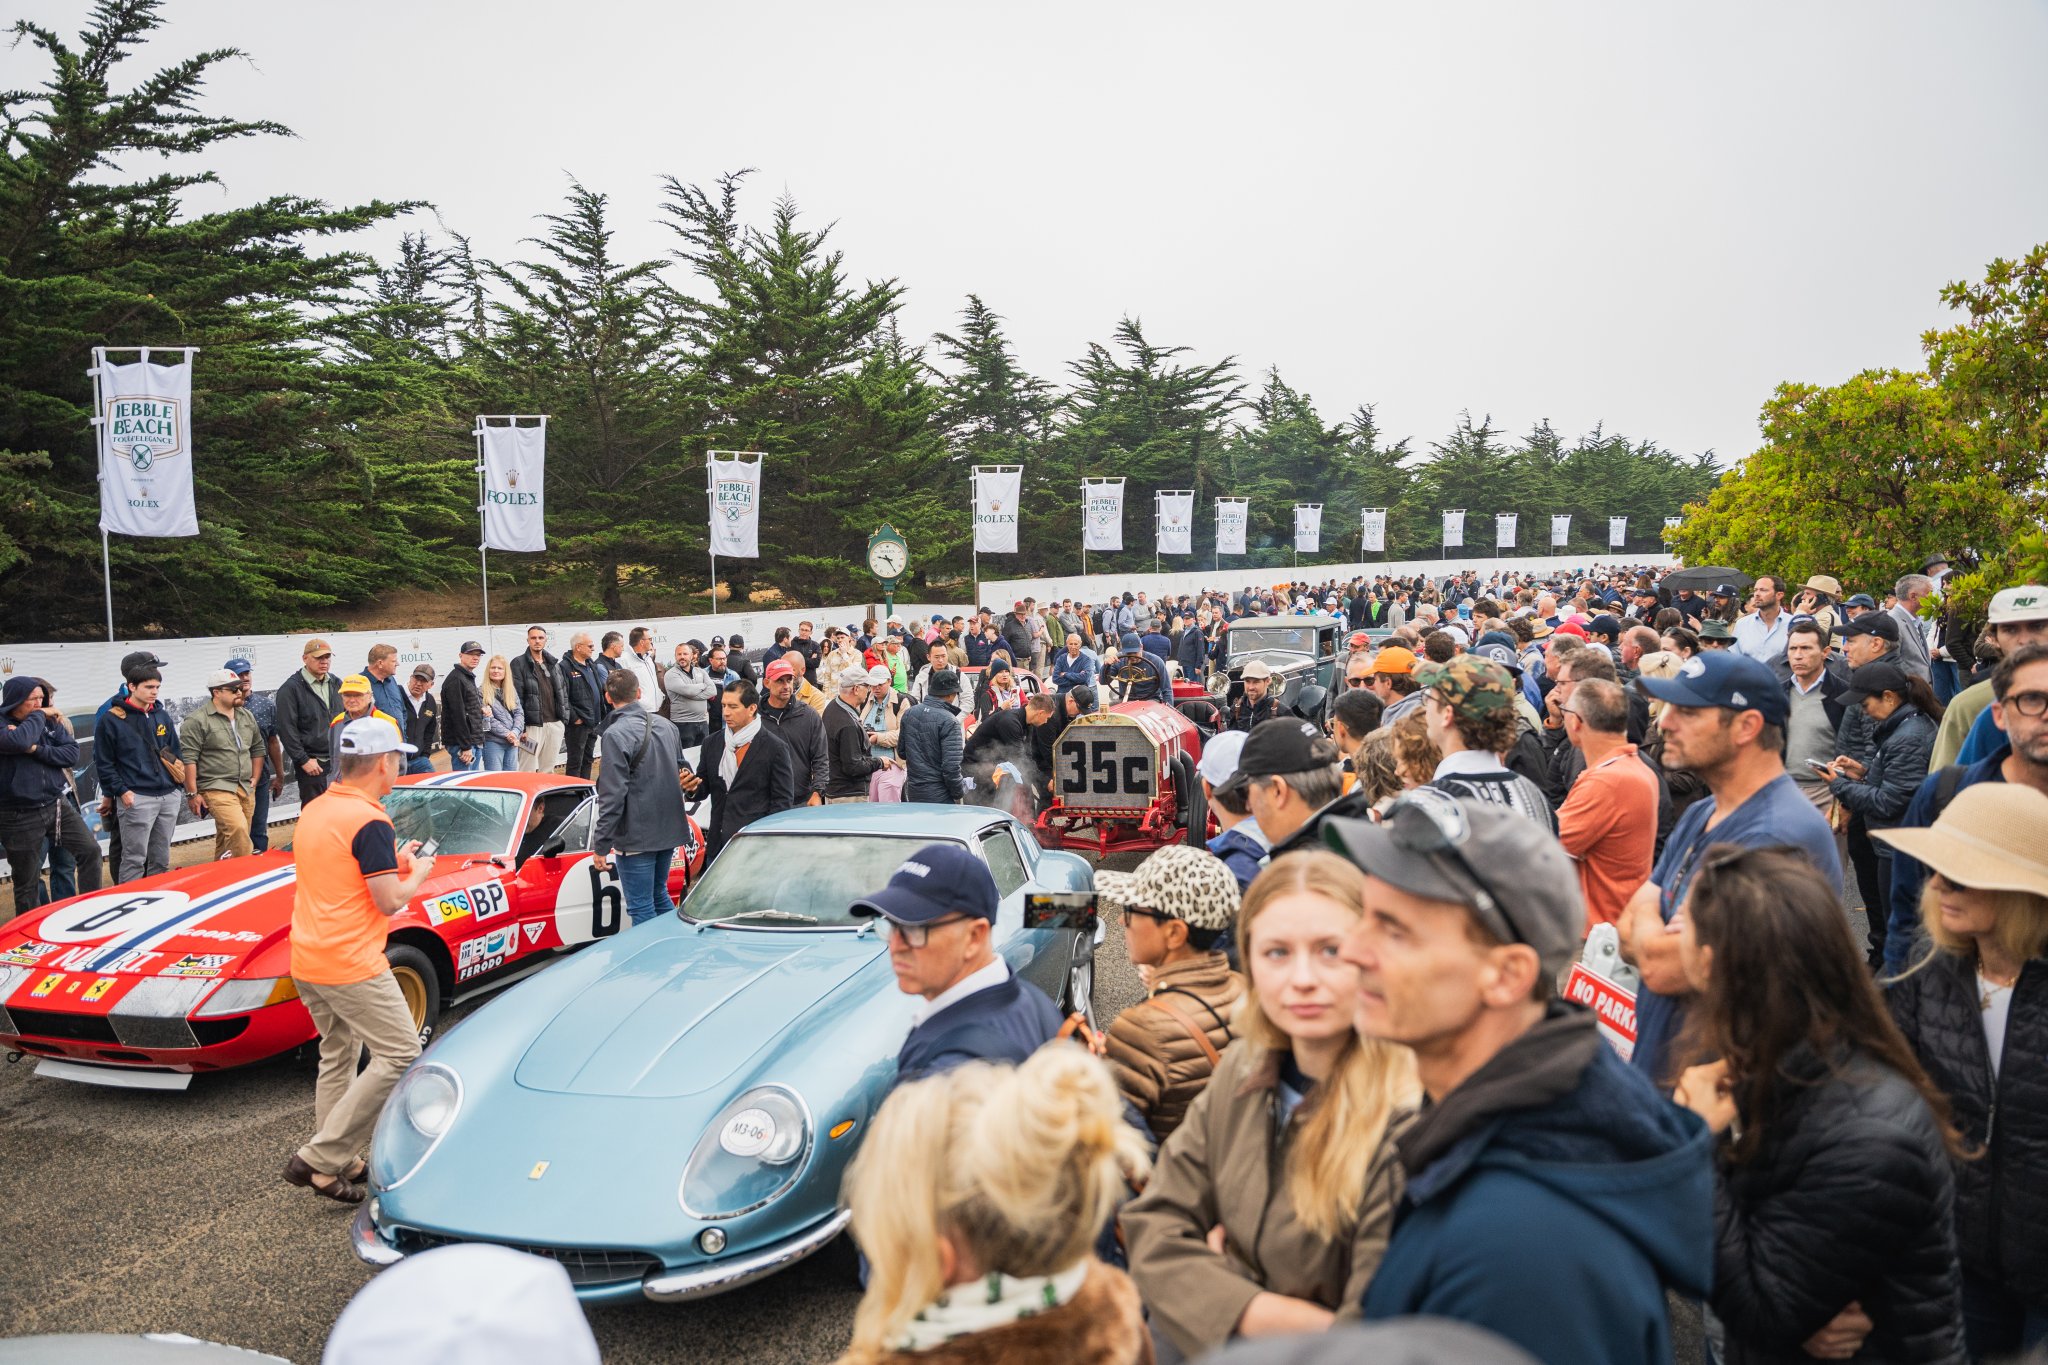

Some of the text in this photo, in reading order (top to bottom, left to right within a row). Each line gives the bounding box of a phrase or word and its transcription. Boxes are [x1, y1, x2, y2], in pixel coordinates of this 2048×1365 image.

[113, 419, 172, 436] BEACH
[718, 482, 752, 493] PEBBLE
[128, 499, 159, 508] ROLEX
[487, 490, 538, 505] ROLEX
[718, 492, 751, 502] BEACH
[1090, 504, 1117, 512] BEACH
[977, 514, 1015, 523] ROLEX
[1161, 525, 1189, 533] ROLEX
[400, 652, 433, 662] ROLEX
[440, 895, 469, 916] GTS
[471, 883, 503, 917] BP
[589, 862, 621, 938] 6
[65, 897, 164, 931] 6
[460, 955, 503, 980] FERODO
[1572, 978, 1595, 1004] NO
